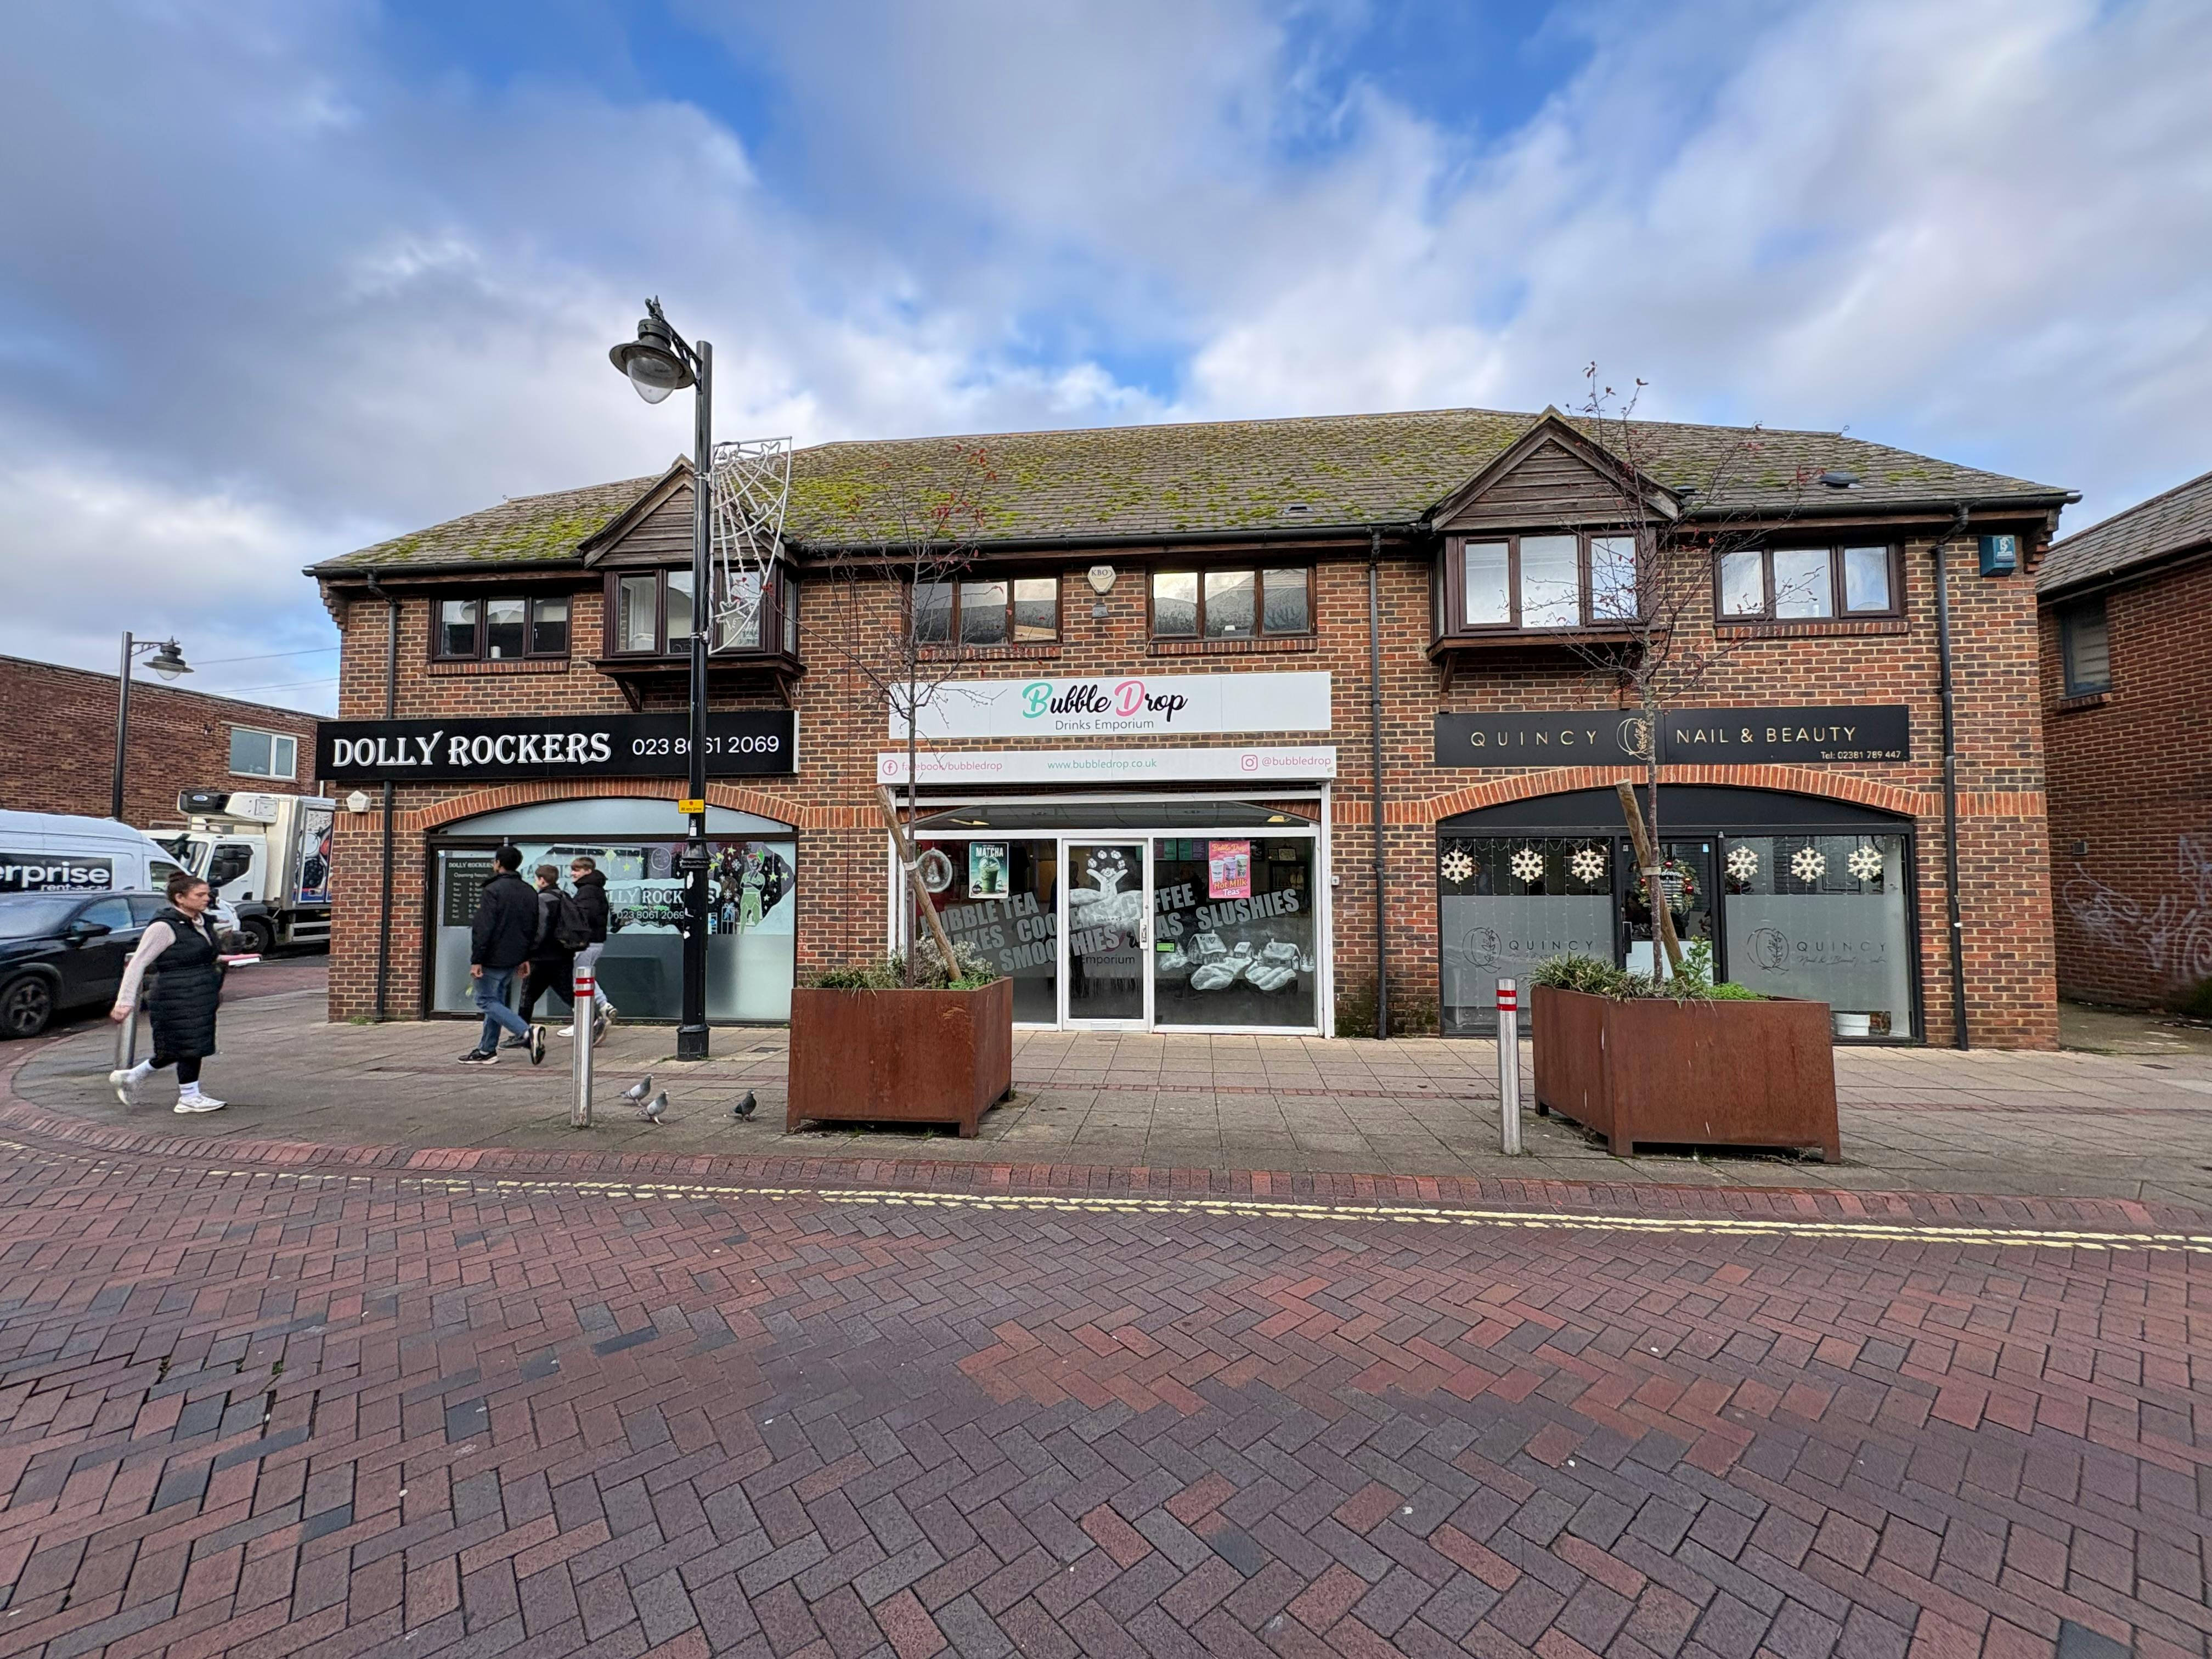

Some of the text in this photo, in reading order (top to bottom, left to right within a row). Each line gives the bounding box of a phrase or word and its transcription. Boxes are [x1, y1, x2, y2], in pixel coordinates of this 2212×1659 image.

[1022, 680, 1188, 723] Bubble Drop
[1055, 718, 1154, 733] Drinks Emporium
[1470, 726, 1857, 747] QUINCY NAIL & BEAUTY
[332, 730, 445, 767] DOLLY
[448, 732, 612, 767] ROCKERS
[632, 738, 669, 755] 023
[727, 735, 780, 754] 2069
[1820, 750, 1901, 759] Tel: 02381 789 447
[902, 761, 1003, 772] faebook/bubbledrop
[1047, 758, 1158, 770] www.bubbledrop.co.uk
[1262, 756, 1331, 767] @bubbledrop
[975, 847, 1004, 857] MATCHA
[0, 861, 110, 888] rprise
[1214, 882, 1229, 890] Hot
[1222, 888, 1240, 896] Teas
[999, 891, 1040, 920] TEA
[617, 911, 685, 919] 023 8061 2069
[998, 925, 1120, 972] SMOOHIES
[1195, 888, 1300, 930] SLUSHIES
[1509, 940, 1593, 951] QUINCY
[1797, 941, 1886, 952] QUINCY
